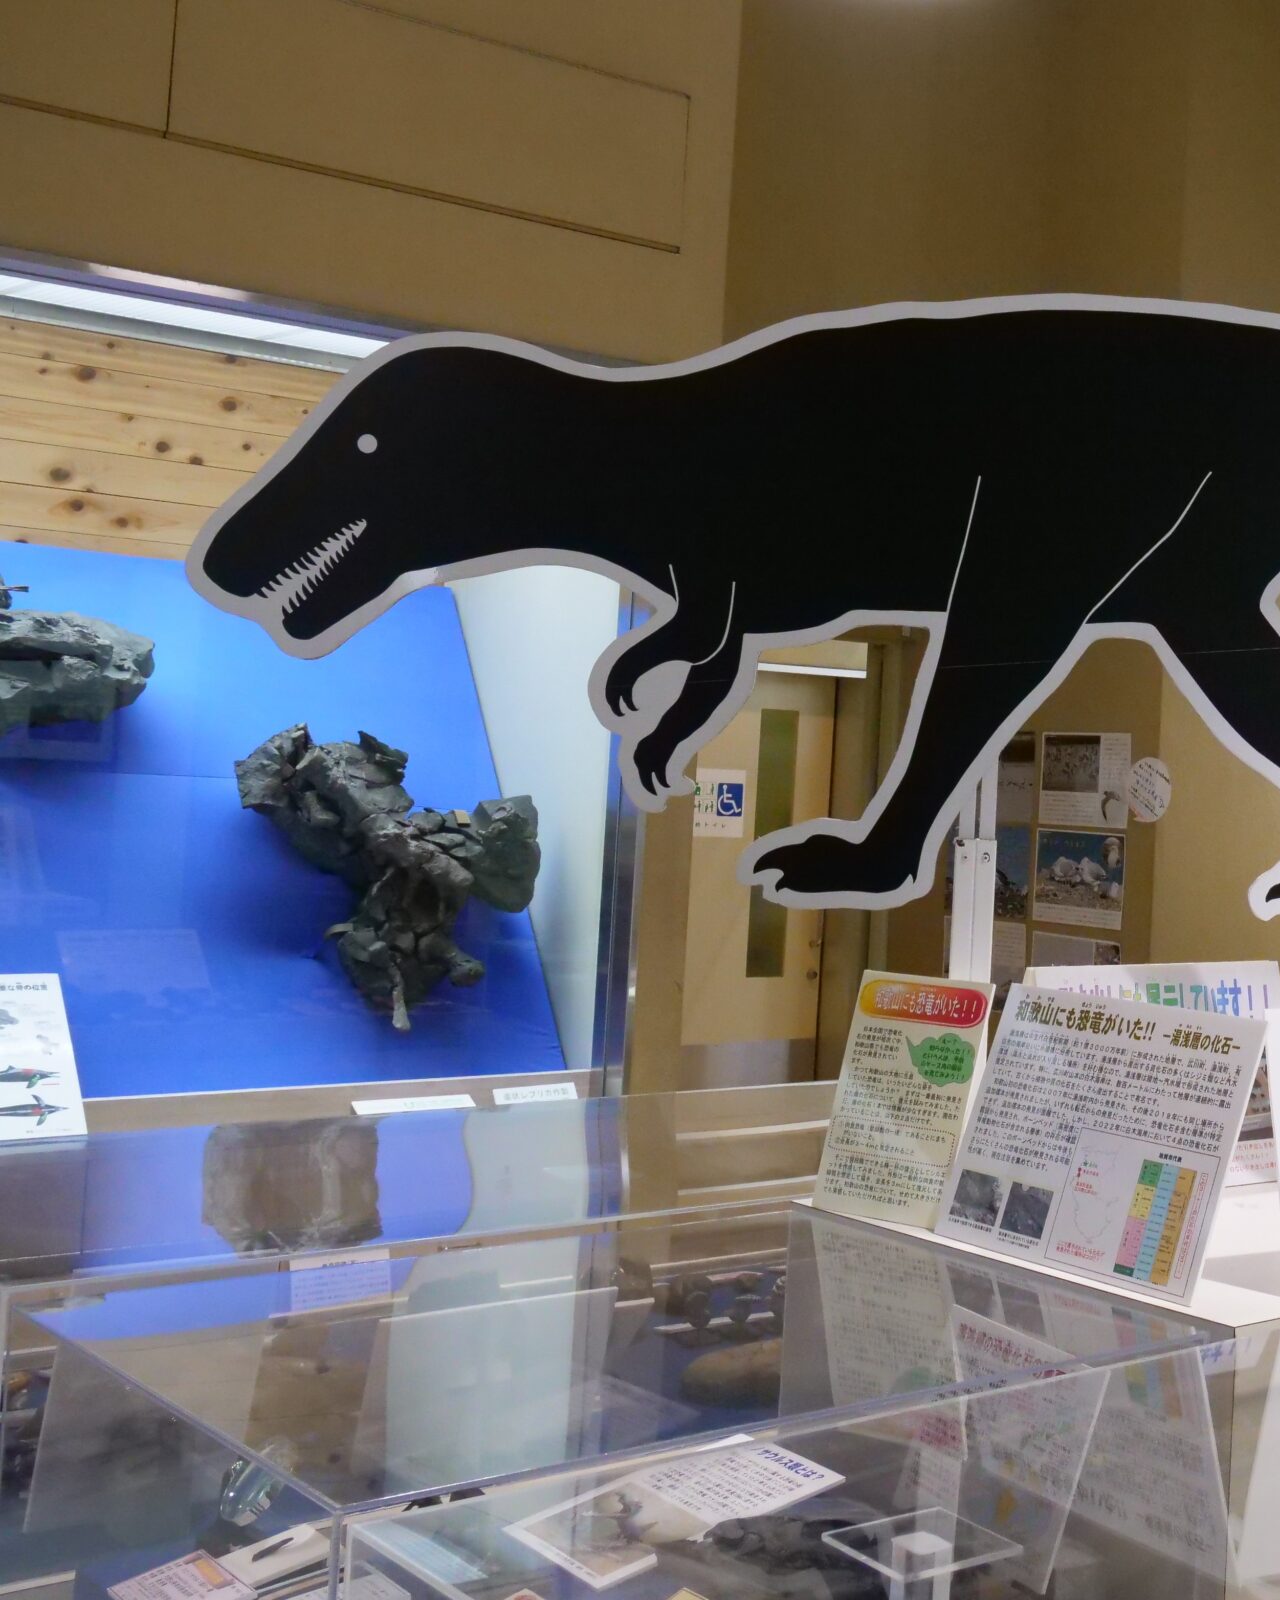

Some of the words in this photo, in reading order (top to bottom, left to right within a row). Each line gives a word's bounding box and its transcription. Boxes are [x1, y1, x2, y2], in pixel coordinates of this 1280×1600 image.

[874, 988, 979, 1019] 和歌山にも恐竜がいた！！
[1015, 998, 1157, 1041] 和歌山にも恐竜がいた!!
